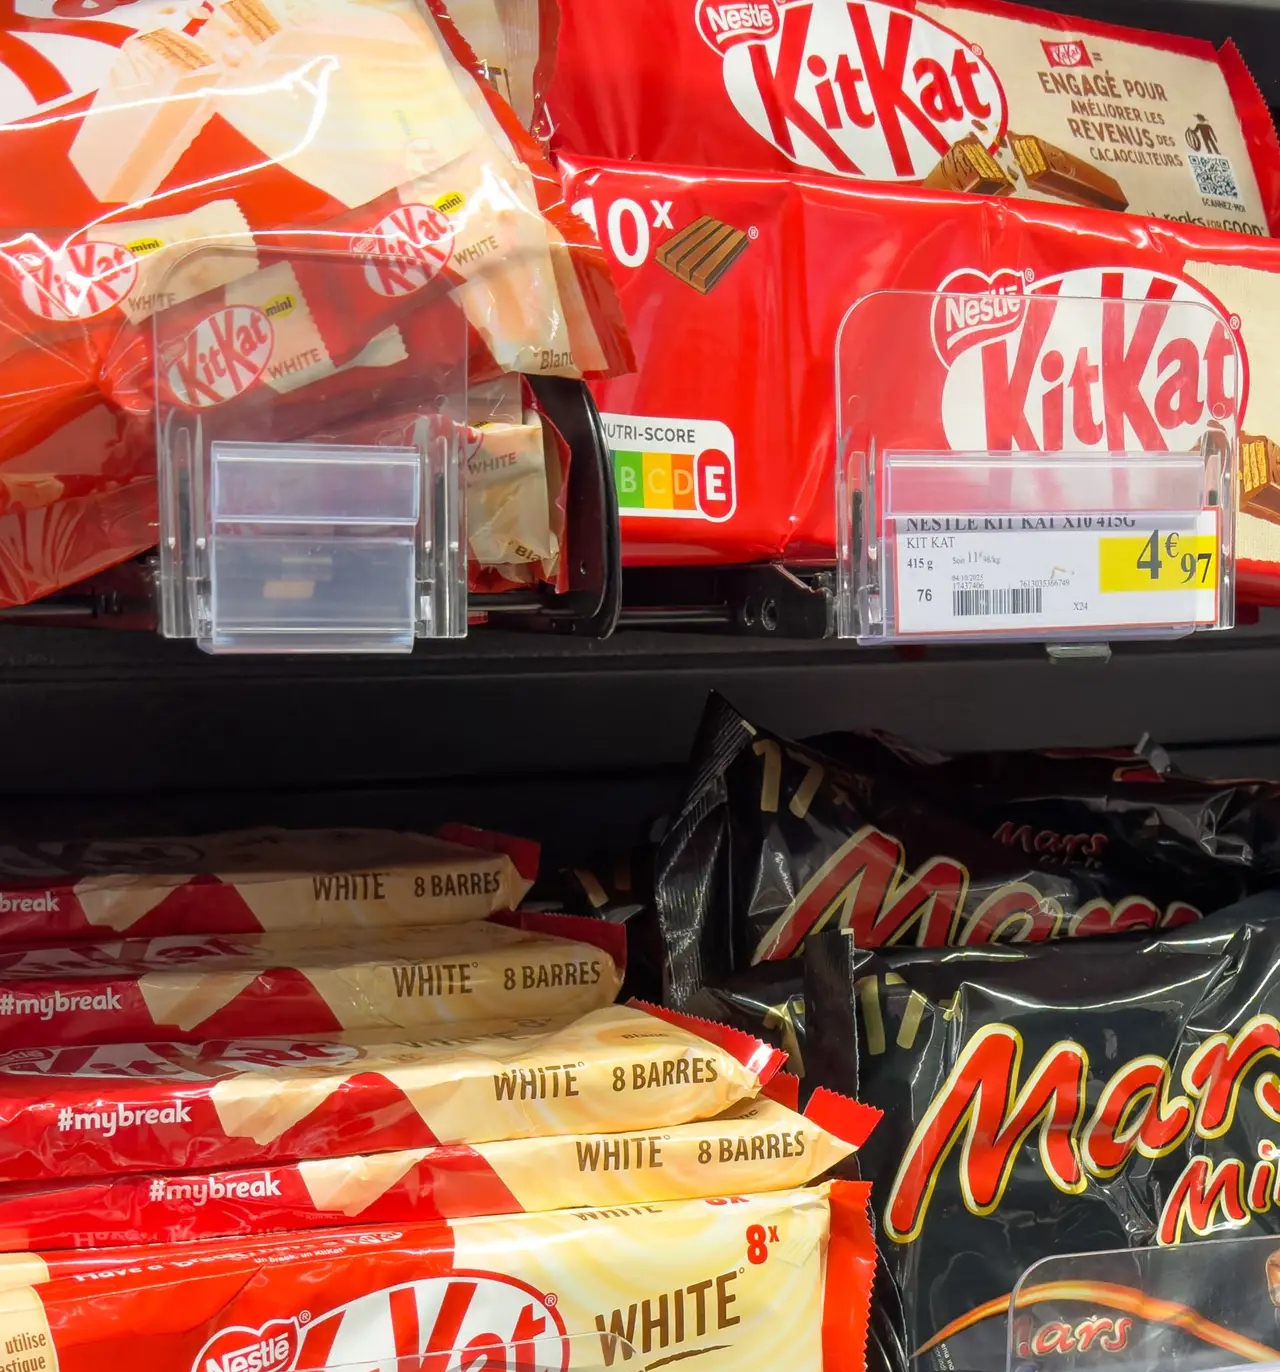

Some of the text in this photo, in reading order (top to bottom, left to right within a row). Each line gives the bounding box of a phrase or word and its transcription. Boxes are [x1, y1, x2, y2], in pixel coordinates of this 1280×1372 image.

[748, 0, 994, 178] KitKat
[1037, 69, 1169, 102] ENGAGÉ POUR
[1069, 98, 1166, 126] AMÉLIORER LES
[1066, 117, 1177, 149] REVENUS DES
[1089, 146, 1184, 168] CACAOCULTEURS
[438, 194, 463, 213] mini
[130, 241, 162, 253] mini
[453, 236, 499, 266] WHITE
[127, 293, 176, 312] WHITE
[167, 300, 293, 406] KitKat mini
[267, 347, 322, 381] WHITE
[906, 535, 956, 549] KIT KAT
[906, 557, 926, 569] 415
[917, 588, 1089, 612] 76 X24
[414, 869, 501, 899] 8 BARRES
[502, 960, 602, 992] 8 BARRES
[611, 1058, 719, 1092] 8 BARRES
[56, 1101, 193, 1138] #mybreak
[697, 1130, 806, 1165] 8 BARRES
[148, 1170, 282, 1203] #mybreak
[4, 1331, 47, 1353] utilise
